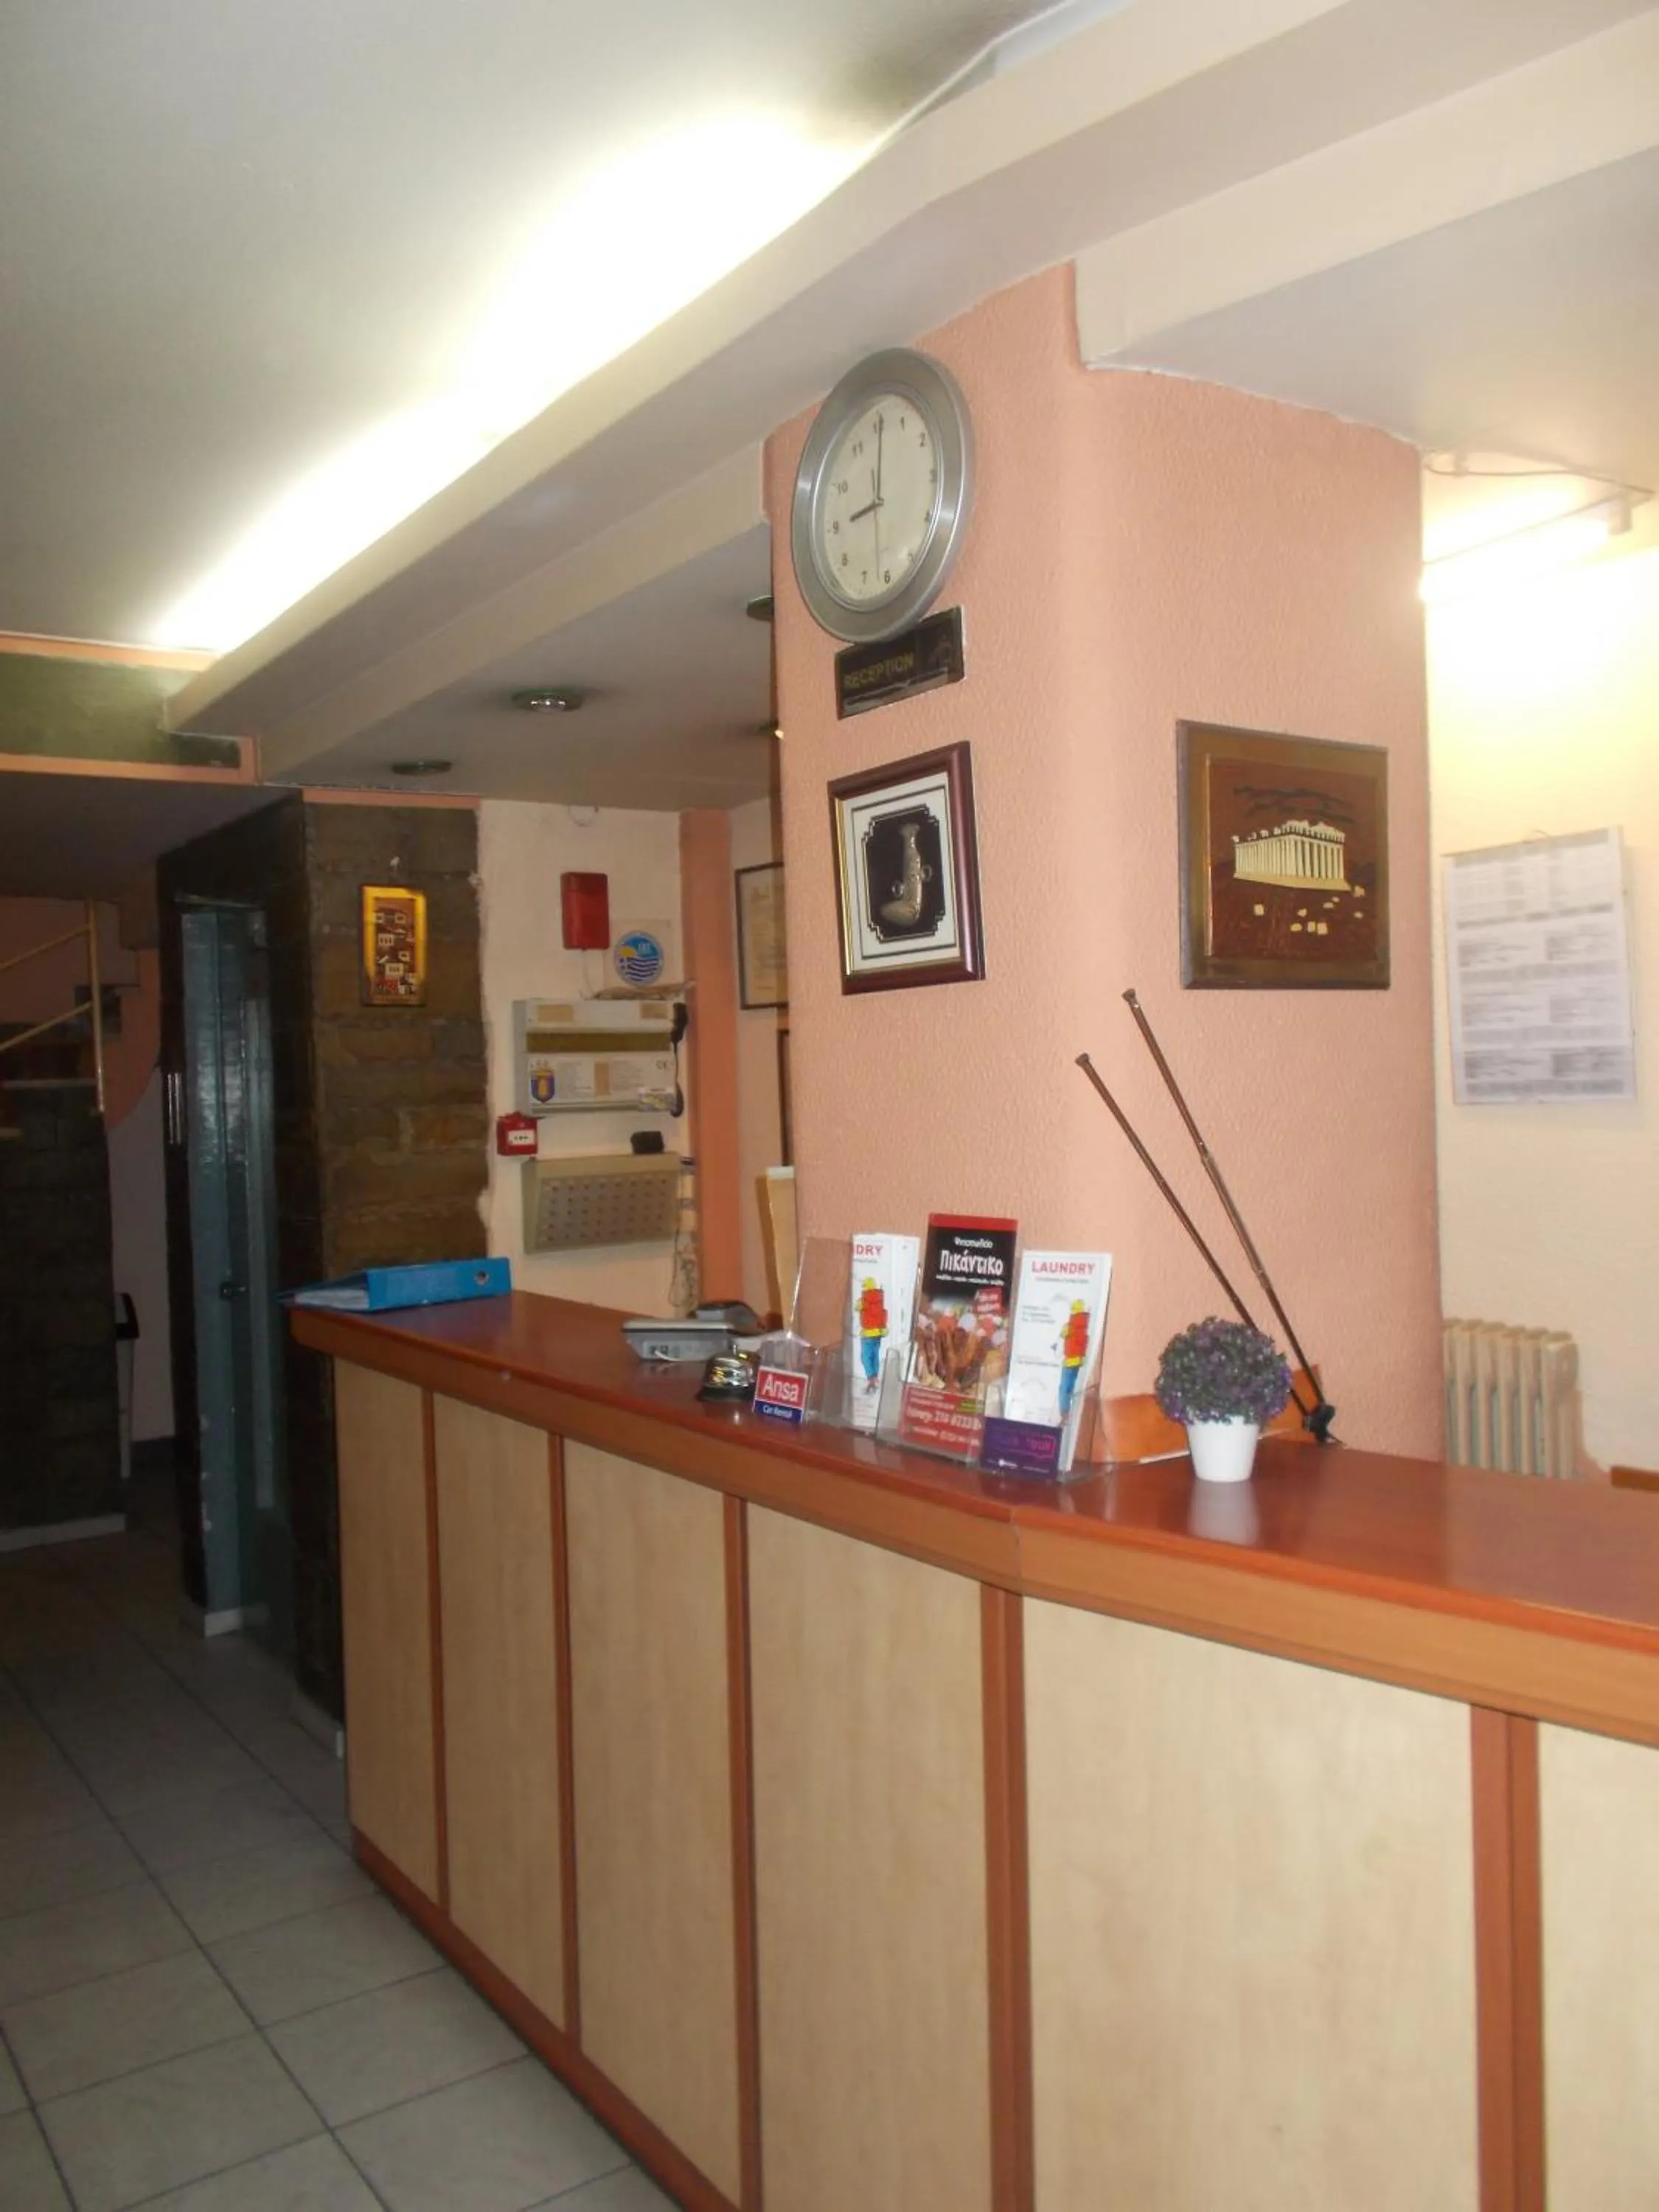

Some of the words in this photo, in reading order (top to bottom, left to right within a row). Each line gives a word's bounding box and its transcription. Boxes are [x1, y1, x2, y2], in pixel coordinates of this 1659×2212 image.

[900, 416, 905, 431] 1
[919, 431, 926, 448] 2
[852, 439, 863, 458] 11
[837, 480, 848, 495] 10
[832, 521, 839, 535] 9
[842, 553, 848, 567] 8
[861, 571, 868, 585] 7
[884, 570, 891, 584] 6
[844, 652, 914, 689] RECEPTION
[856, 1244, 884, 1256] DRY
[939, 1249, 1004, 1276] Πικάντικο
[1032, 1262, 1096, 1275] LAUNDRY
[762, 1374, 799, 1402] Ansa
